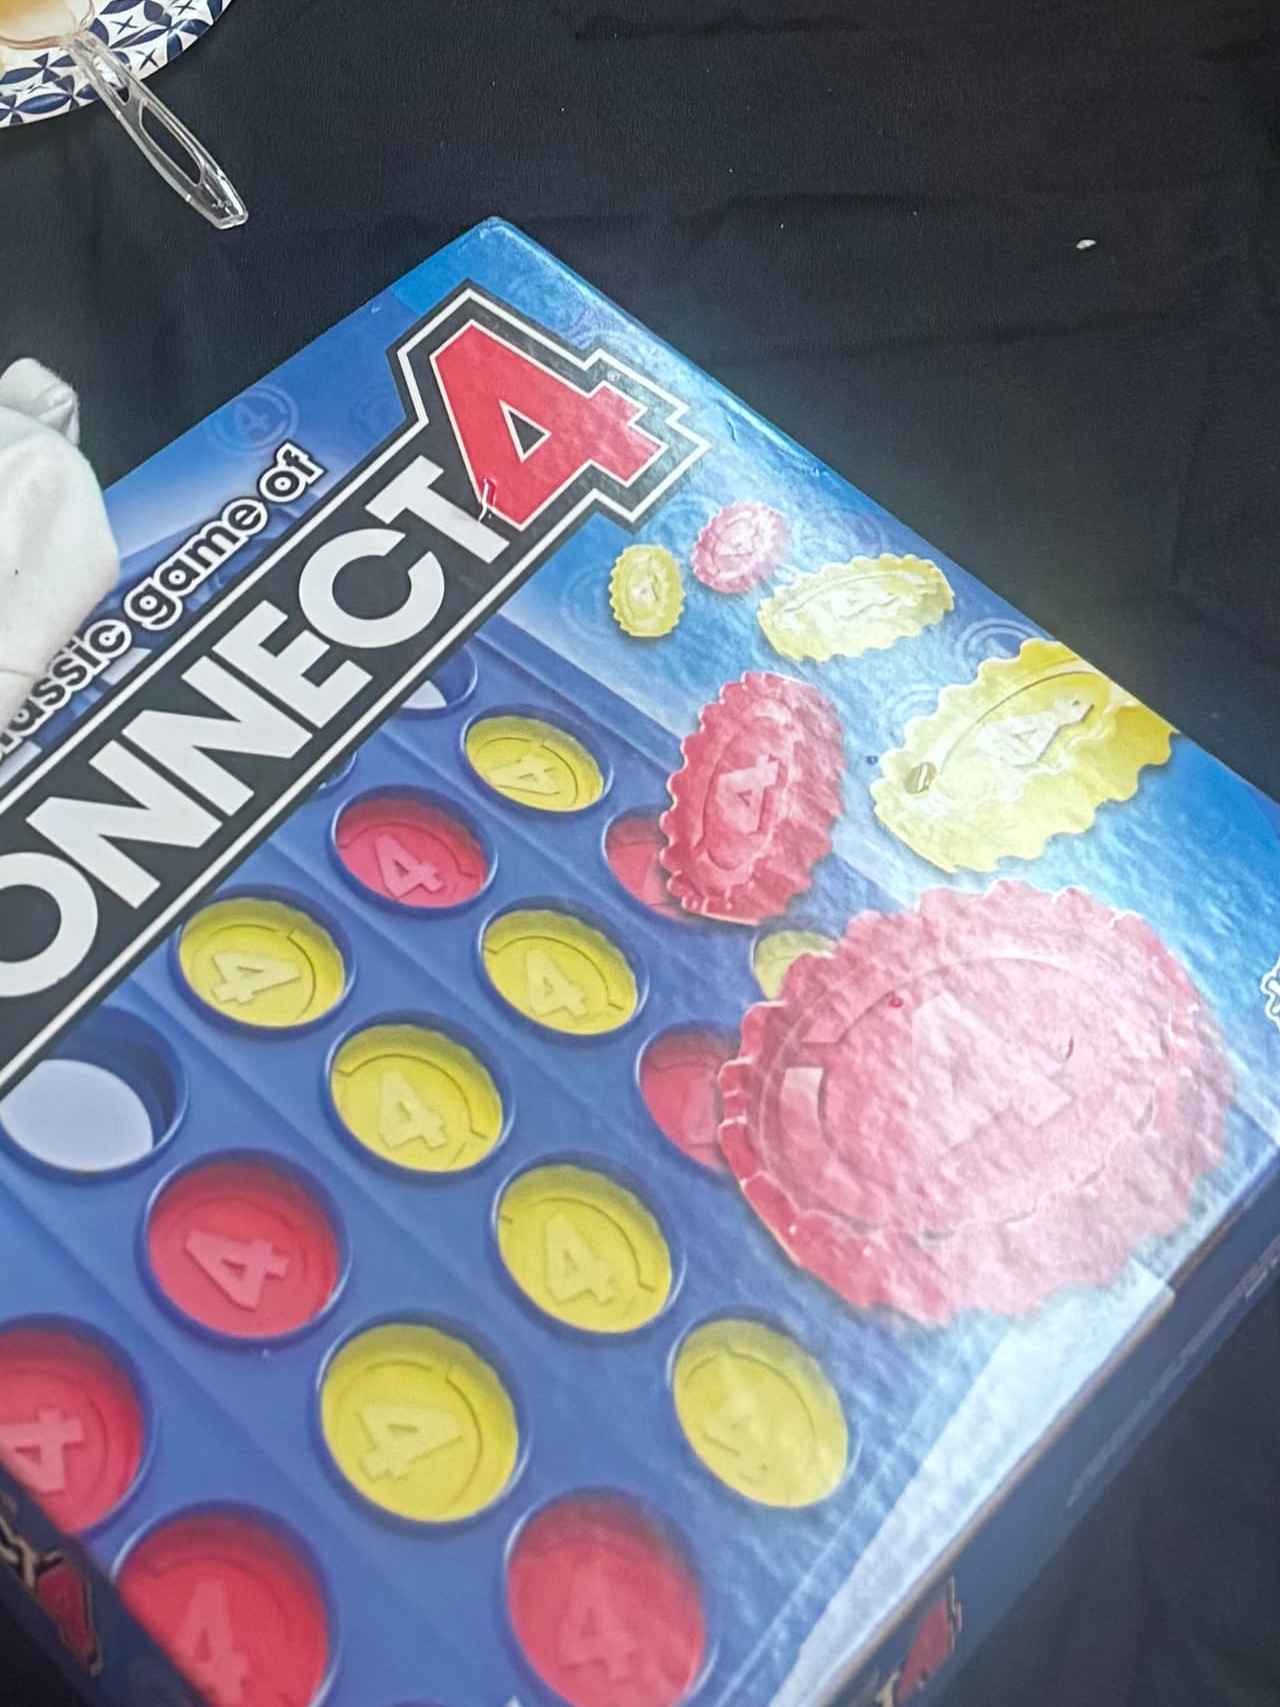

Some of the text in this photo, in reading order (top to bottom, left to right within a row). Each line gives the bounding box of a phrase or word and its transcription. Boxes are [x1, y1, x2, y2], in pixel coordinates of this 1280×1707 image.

[430, 321, 663, 533] 4
[124, 497, 268, 630] game
[259, 440, 328, 503] of
